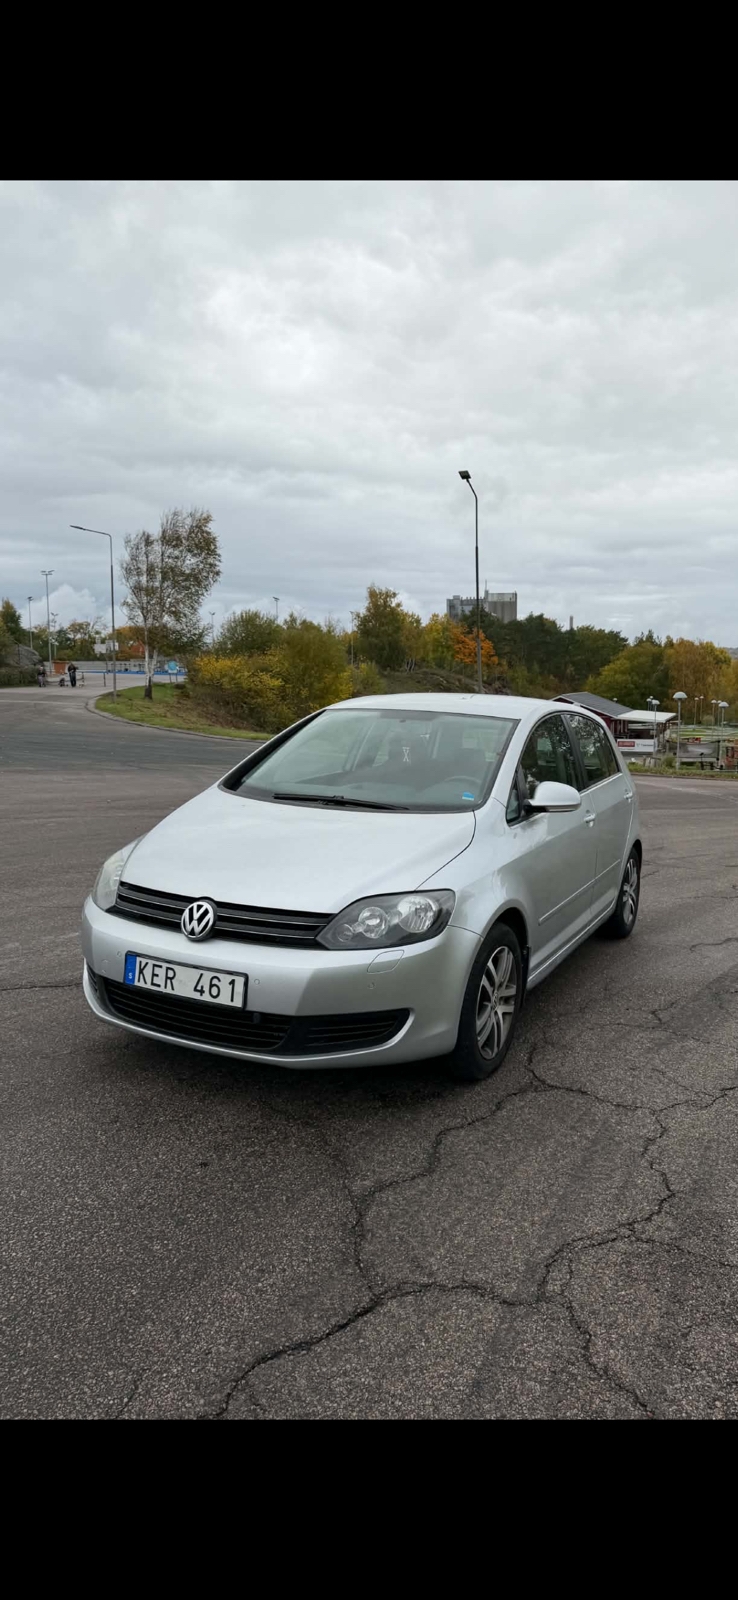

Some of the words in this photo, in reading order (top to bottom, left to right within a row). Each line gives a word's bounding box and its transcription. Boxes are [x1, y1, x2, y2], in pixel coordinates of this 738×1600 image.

[183, 902, 213, 938] VW
[137, 960, 177, 991] KER
[193, 973, 236, 1003] 461
